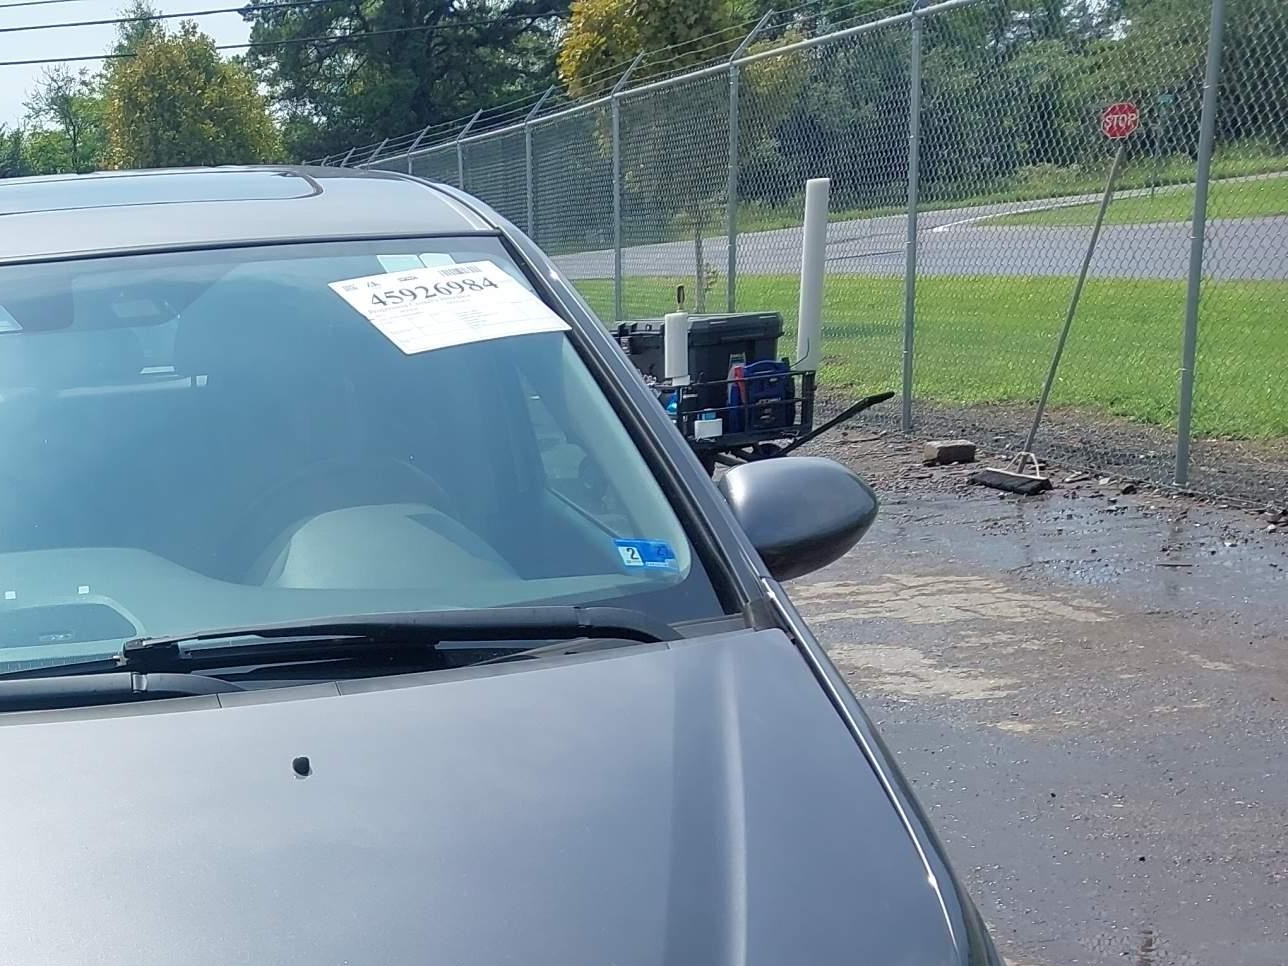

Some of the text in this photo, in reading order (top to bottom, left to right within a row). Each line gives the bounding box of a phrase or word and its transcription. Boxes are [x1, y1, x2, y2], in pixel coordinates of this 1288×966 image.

[1105, 113, 1136, 130] STOP
[371, 276, 499, 308] 45926984
[627, 547, 640, 559] 2
